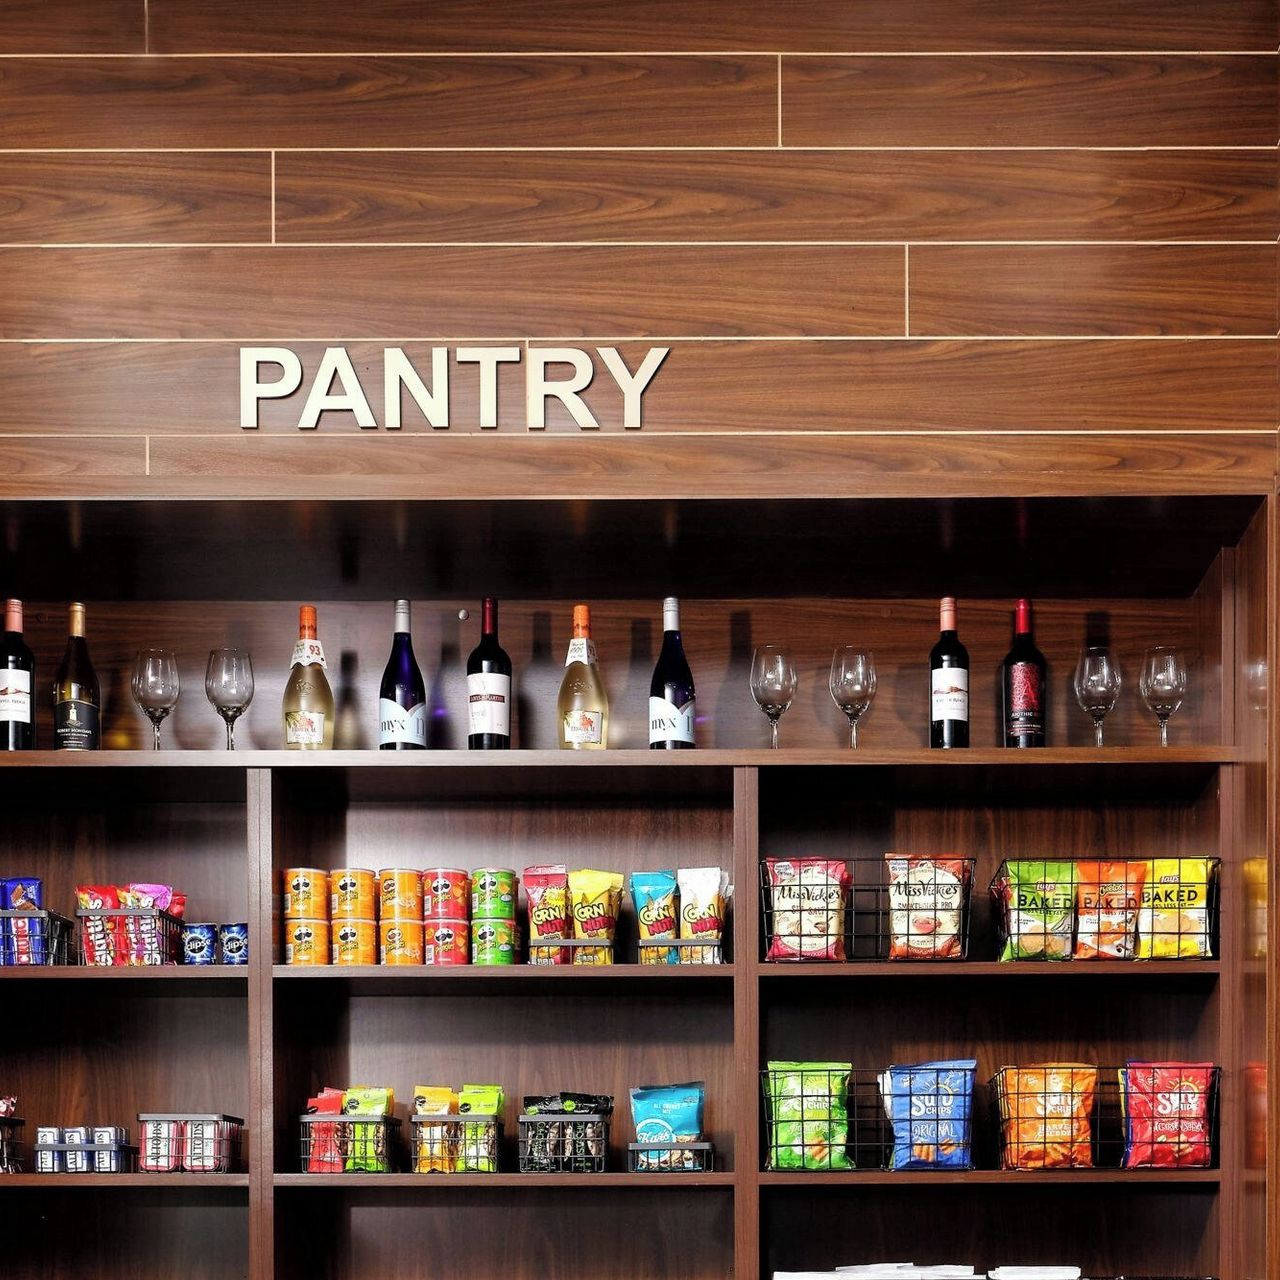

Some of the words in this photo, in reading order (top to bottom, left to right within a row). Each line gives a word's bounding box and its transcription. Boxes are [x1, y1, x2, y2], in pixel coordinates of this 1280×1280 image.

[239, 347, 671, 430] PANTRY
[1019, 893, 1071, 908] BAKED
[1083, 896, 1138, 909] BAKED
[1141, 889, 1198, 904] BAKED
[533, 905, 561, 923] CORN
[574, 903, 605, 921] CORN
[639, 904, 669, 924] CORN
[683, 904, 715, 922] CORN
[12, 916, 32, 965] CRUNC
[925, 1106, 952, 1115] CHIPS
